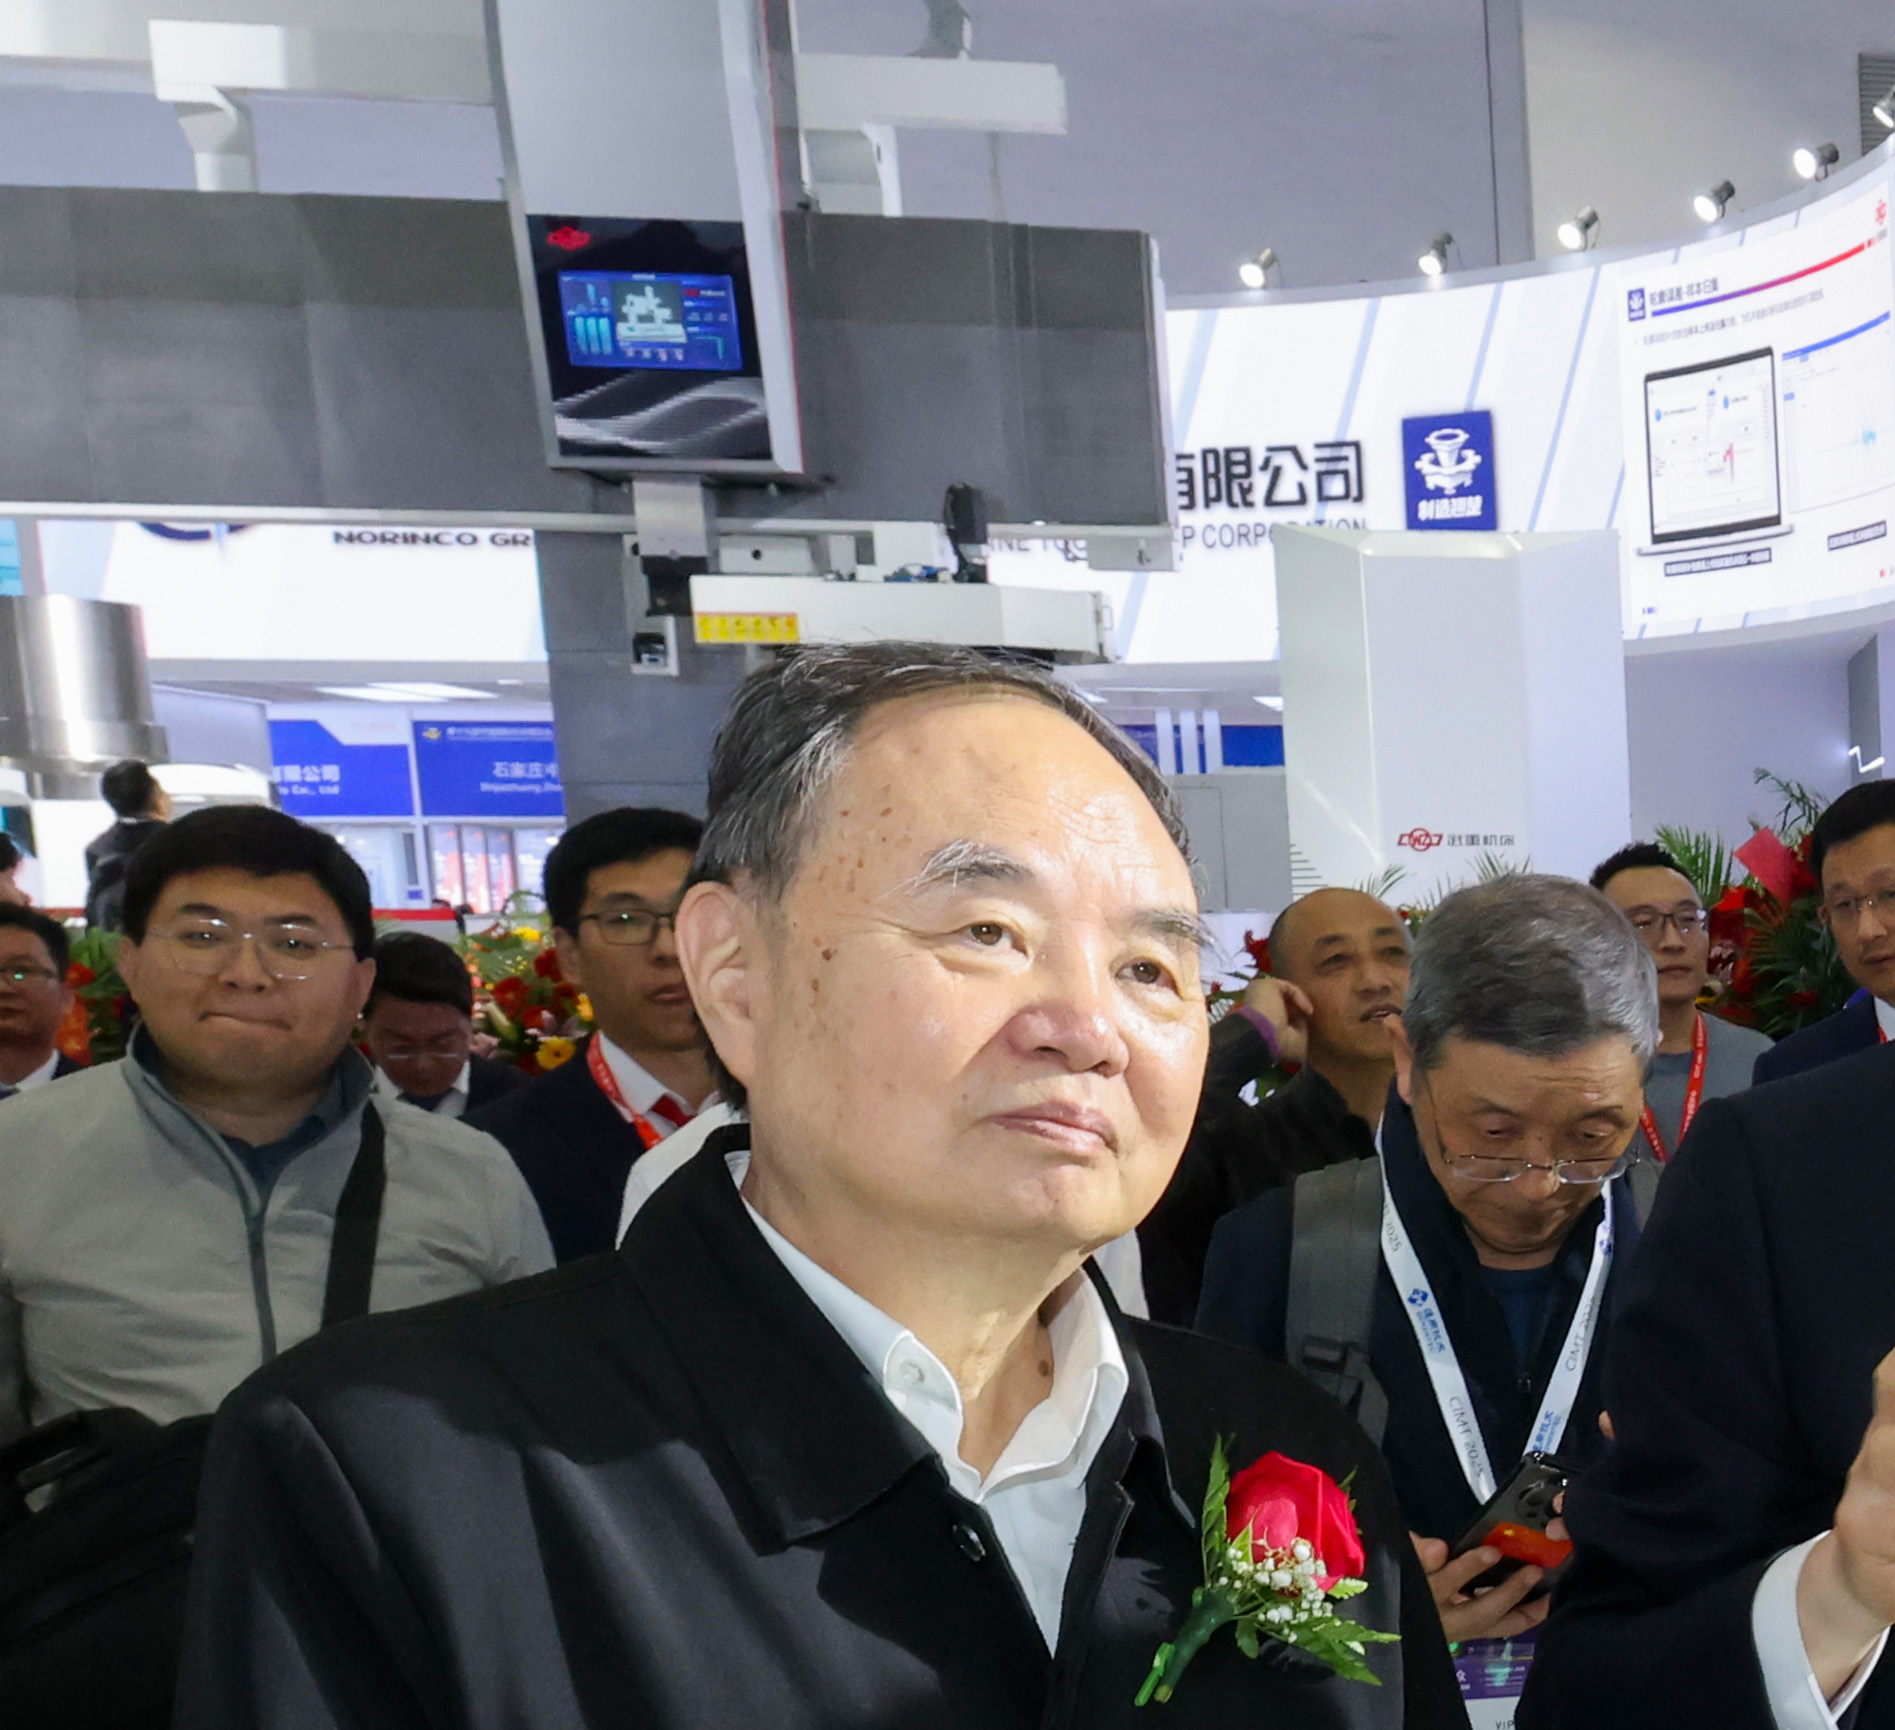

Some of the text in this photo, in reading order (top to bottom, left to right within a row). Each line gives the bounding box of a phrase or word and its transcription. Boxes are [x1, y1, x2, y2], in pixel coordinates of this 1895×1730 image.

[333, 530, 478, 546] NORINCO
[1564, 1333, 1585, 1373] CIMT
[1450, 1395, 1472, 1436] CIMT
